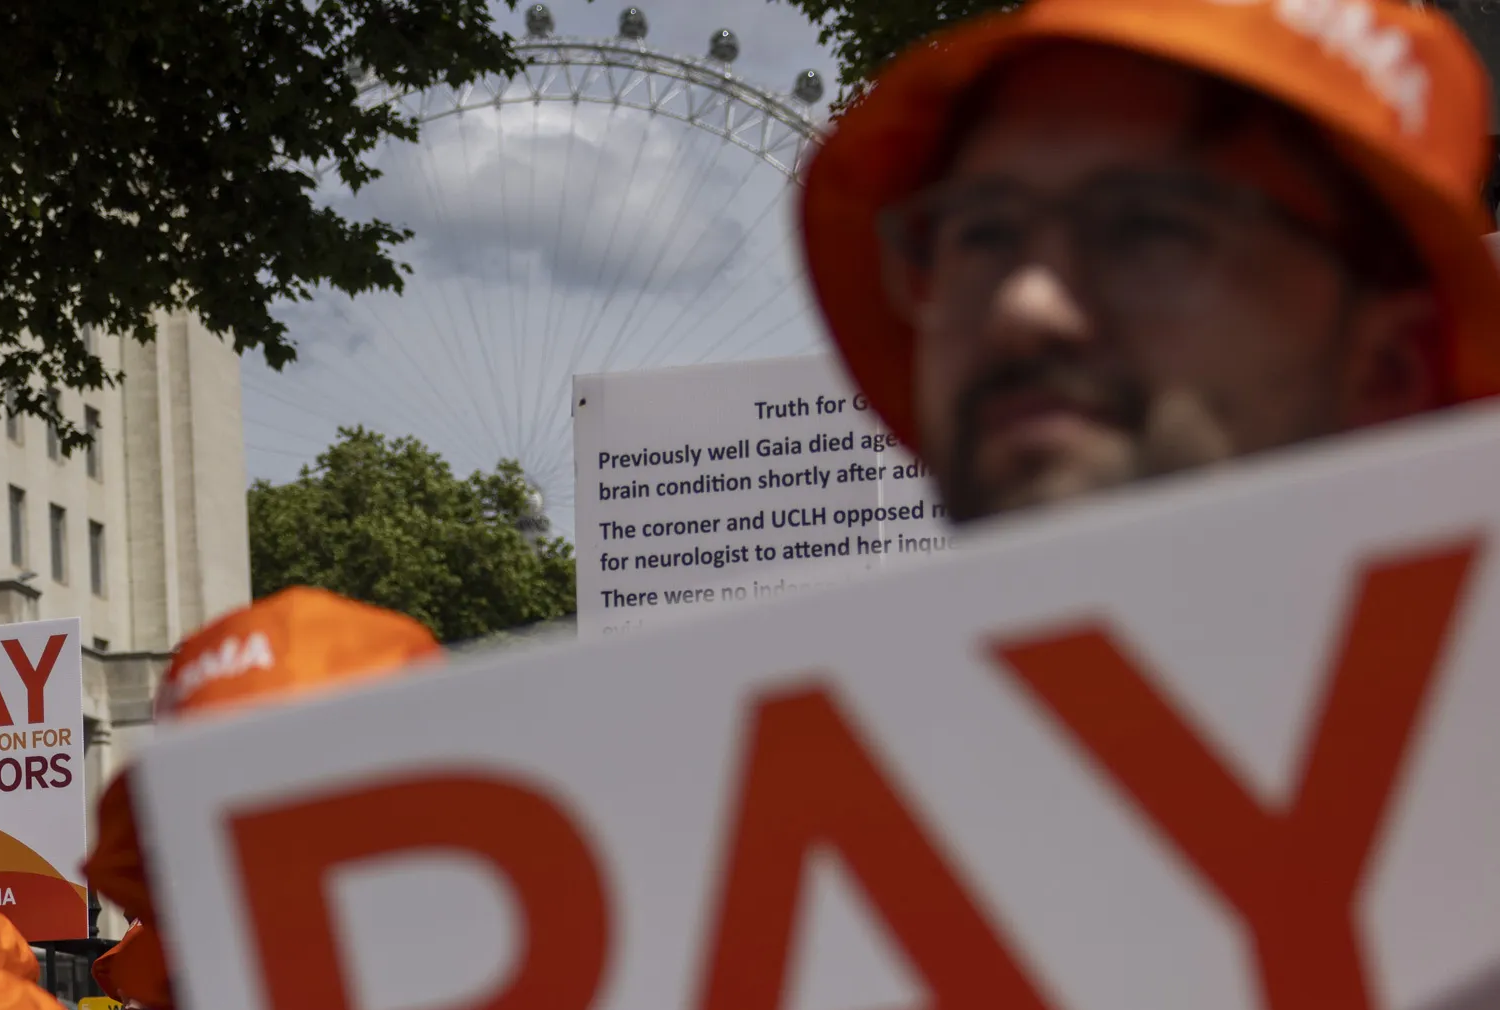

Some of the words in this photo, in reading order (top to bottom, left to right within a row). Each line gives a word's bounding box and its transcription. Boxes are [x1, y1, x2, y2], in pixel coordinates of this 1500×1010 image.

[754, 397, 809, 420] Truth
[815, 395, 846, 415] for
[598, 444, 702, 470] Previously
[707, 439, 750, 461] well
[756, 436, 802, 457] Gaia
[808, 431, 854, 454] died
[599, 479, 650, 501] brain
[655, 473, 751, 497] condition
[757, 465, 831, 489] shortly
[836, 462, 887, 484] after
[599, 520, 636, 541] The
[642, 517, 721, 537] coroner
[726, 510, 764, 532] and
[771, 506, 826, 529] UCLH
[832, 499, 924, 528] opposed
[600, 552, 629, 572] for
[634, 544, 749, 569] neurologist
[754, 543, 776, 562] to
[782, 536, 850, 560] attend
[857, 535, 892, 555] her
[600, 588, 658, 609] There
[663, 587, 715, 605] were
[721, 585, 747, 601] no
[32, 727, 73, 749] FOR
